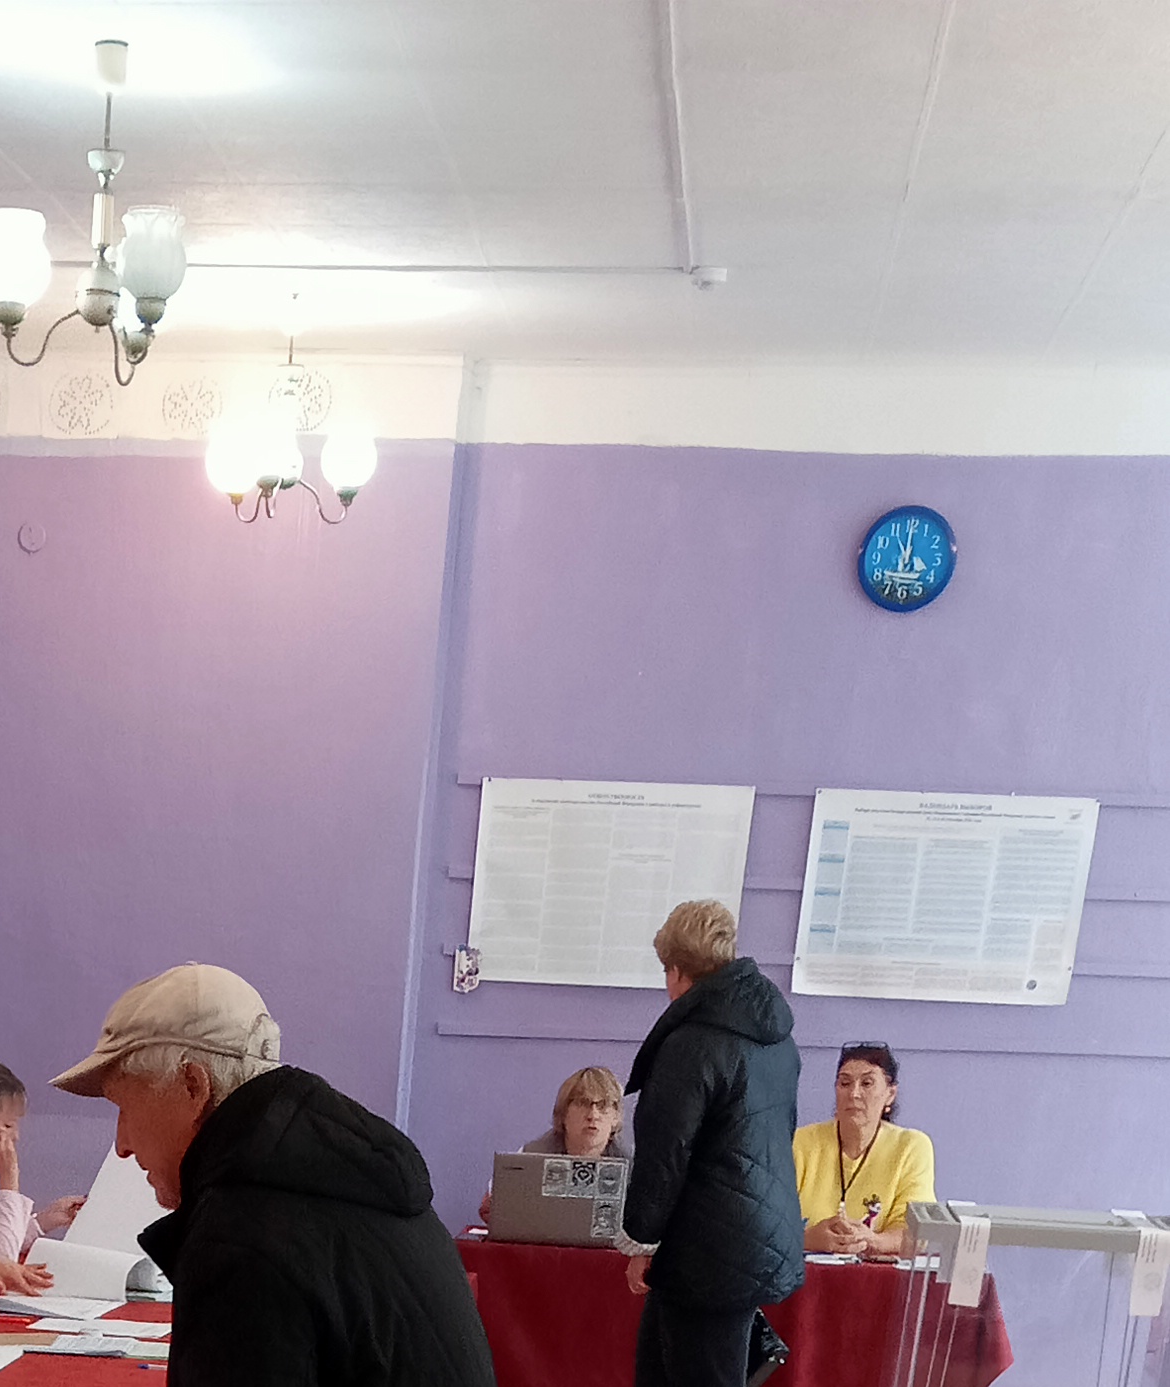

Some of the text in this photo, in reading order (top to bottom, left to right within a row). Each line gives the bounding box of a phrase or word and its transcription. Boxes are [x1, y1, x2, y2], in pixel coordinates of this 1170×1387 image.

[891, 523, 901, 537] 11
[906, 518, 920, 533] 12
[923, 523, 929, 537] 1
[876, 535, 890, 550] 10
[931, 535, 941, 549] 2
[872, 551, 881, 565] 9
[932, 552, 943, 566] 3
[873, 568, 882, 581] 8
[925, 569, 935, 584] 4
[883, 581, 892, 595] 7
[897, 586, 907, 599] 6
[912, 581, 923, 596] 5
